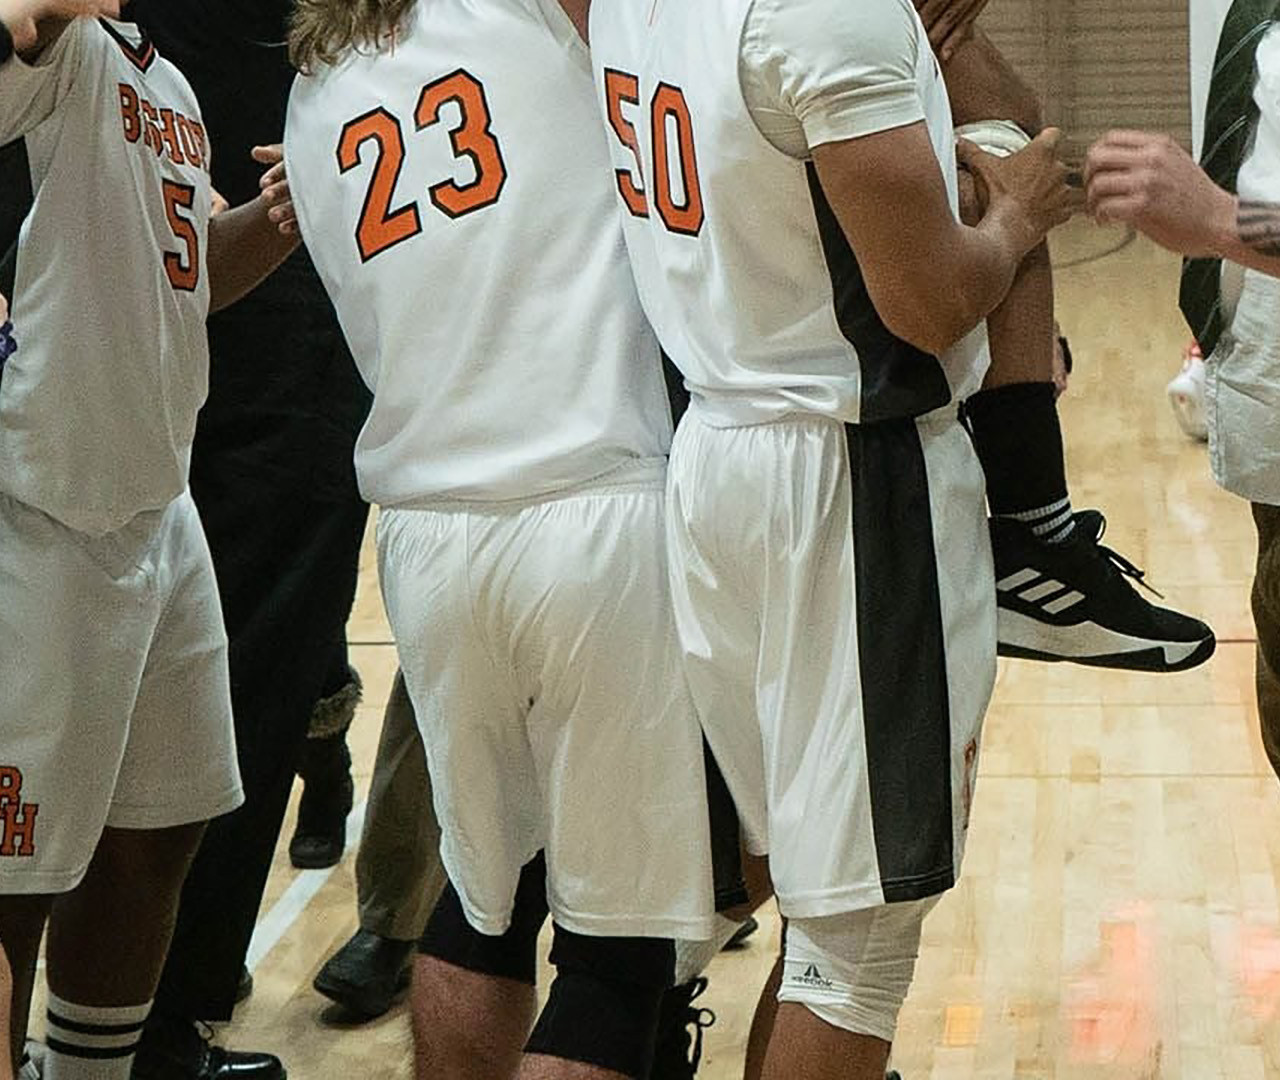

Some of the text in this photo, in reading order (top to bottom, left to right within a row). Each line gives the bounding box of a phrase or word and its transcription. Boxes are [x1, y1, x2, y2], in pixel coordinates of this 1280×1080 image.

[162, 177, 199, 292] 5
[337, 67, 508, 264] 23
[603, 67, 704, 237] 50
